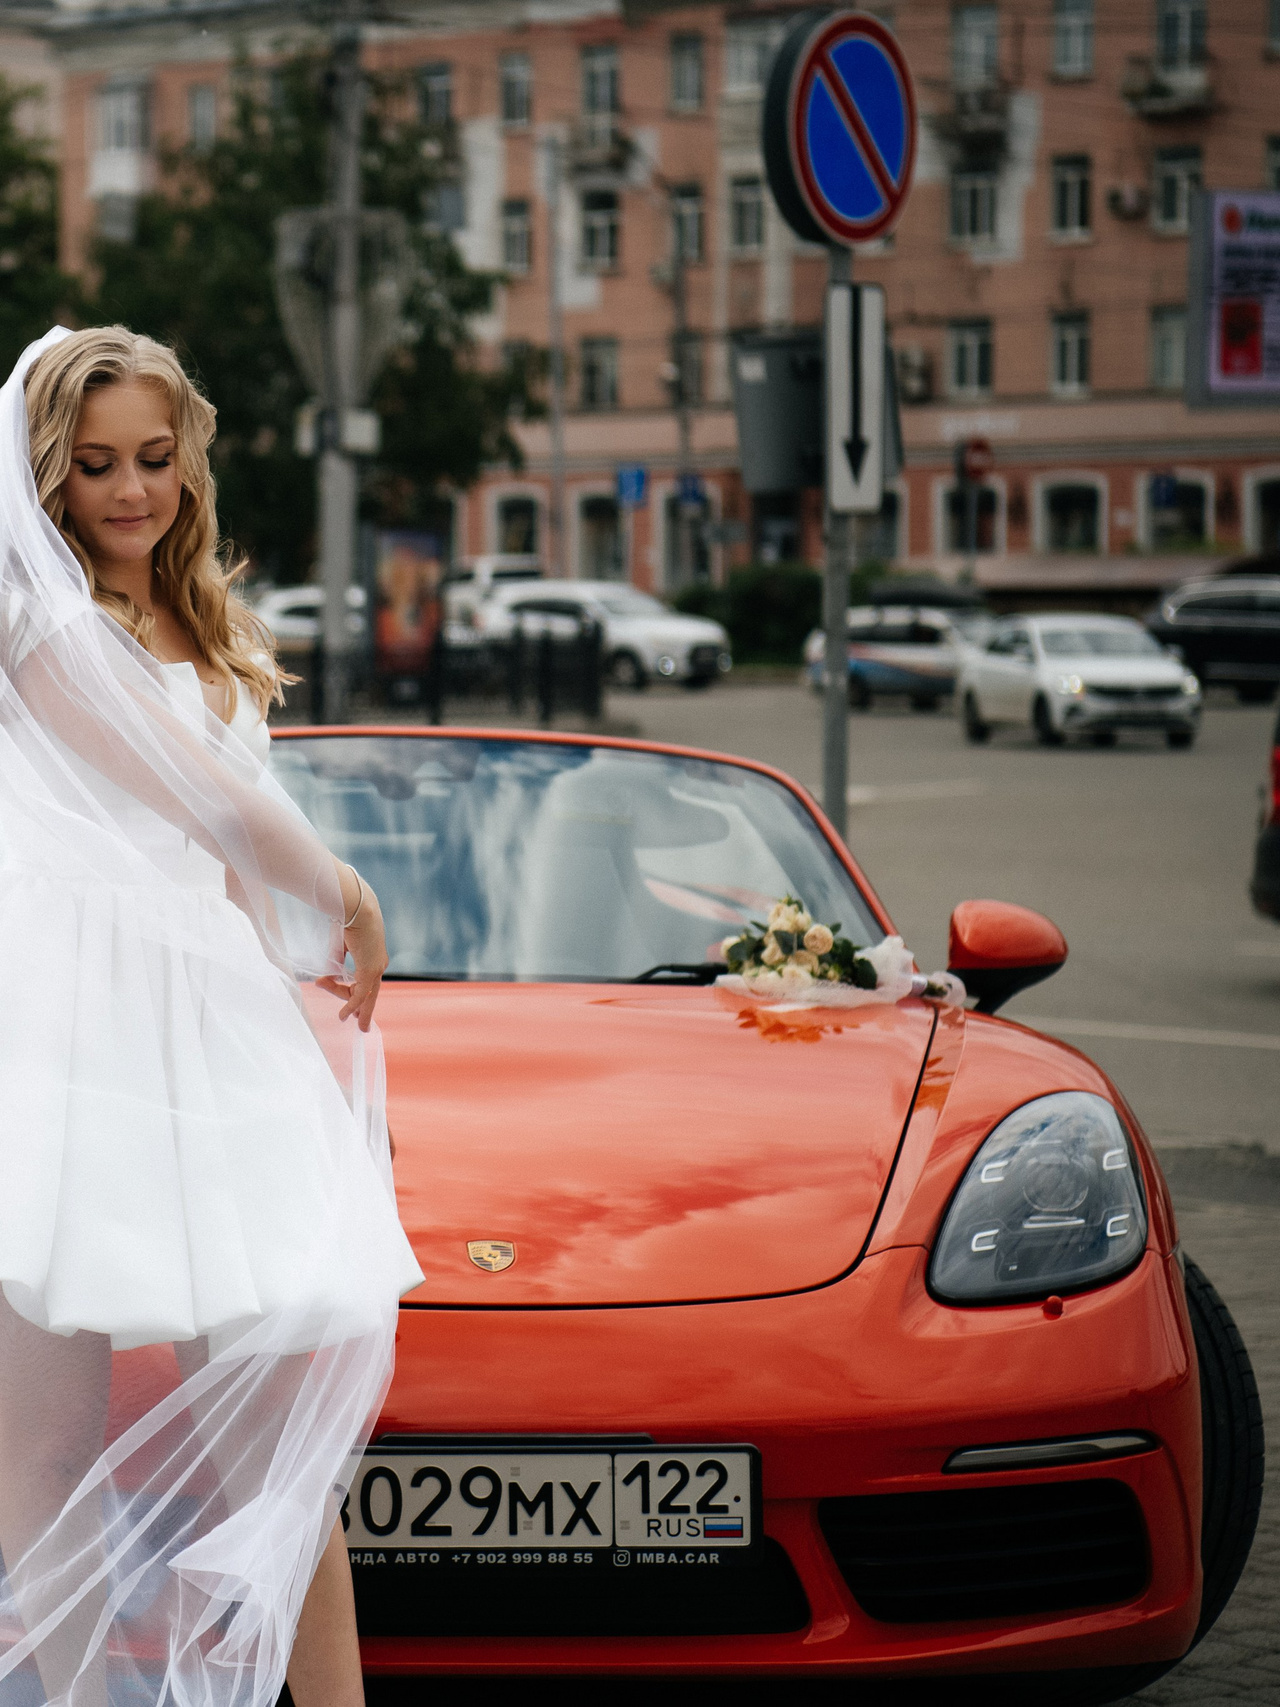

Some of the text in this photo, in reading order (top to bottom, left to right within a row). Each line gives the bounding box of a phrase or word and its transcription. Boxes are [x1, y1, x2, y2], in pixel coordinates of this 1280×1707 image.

[647, 1518, 701, 1538] RUS
[349, 1552, 593, 1565] НДА АВТО +7 902 999 88 55
[636, 1552, 720, 1564] IMBA.CAR
